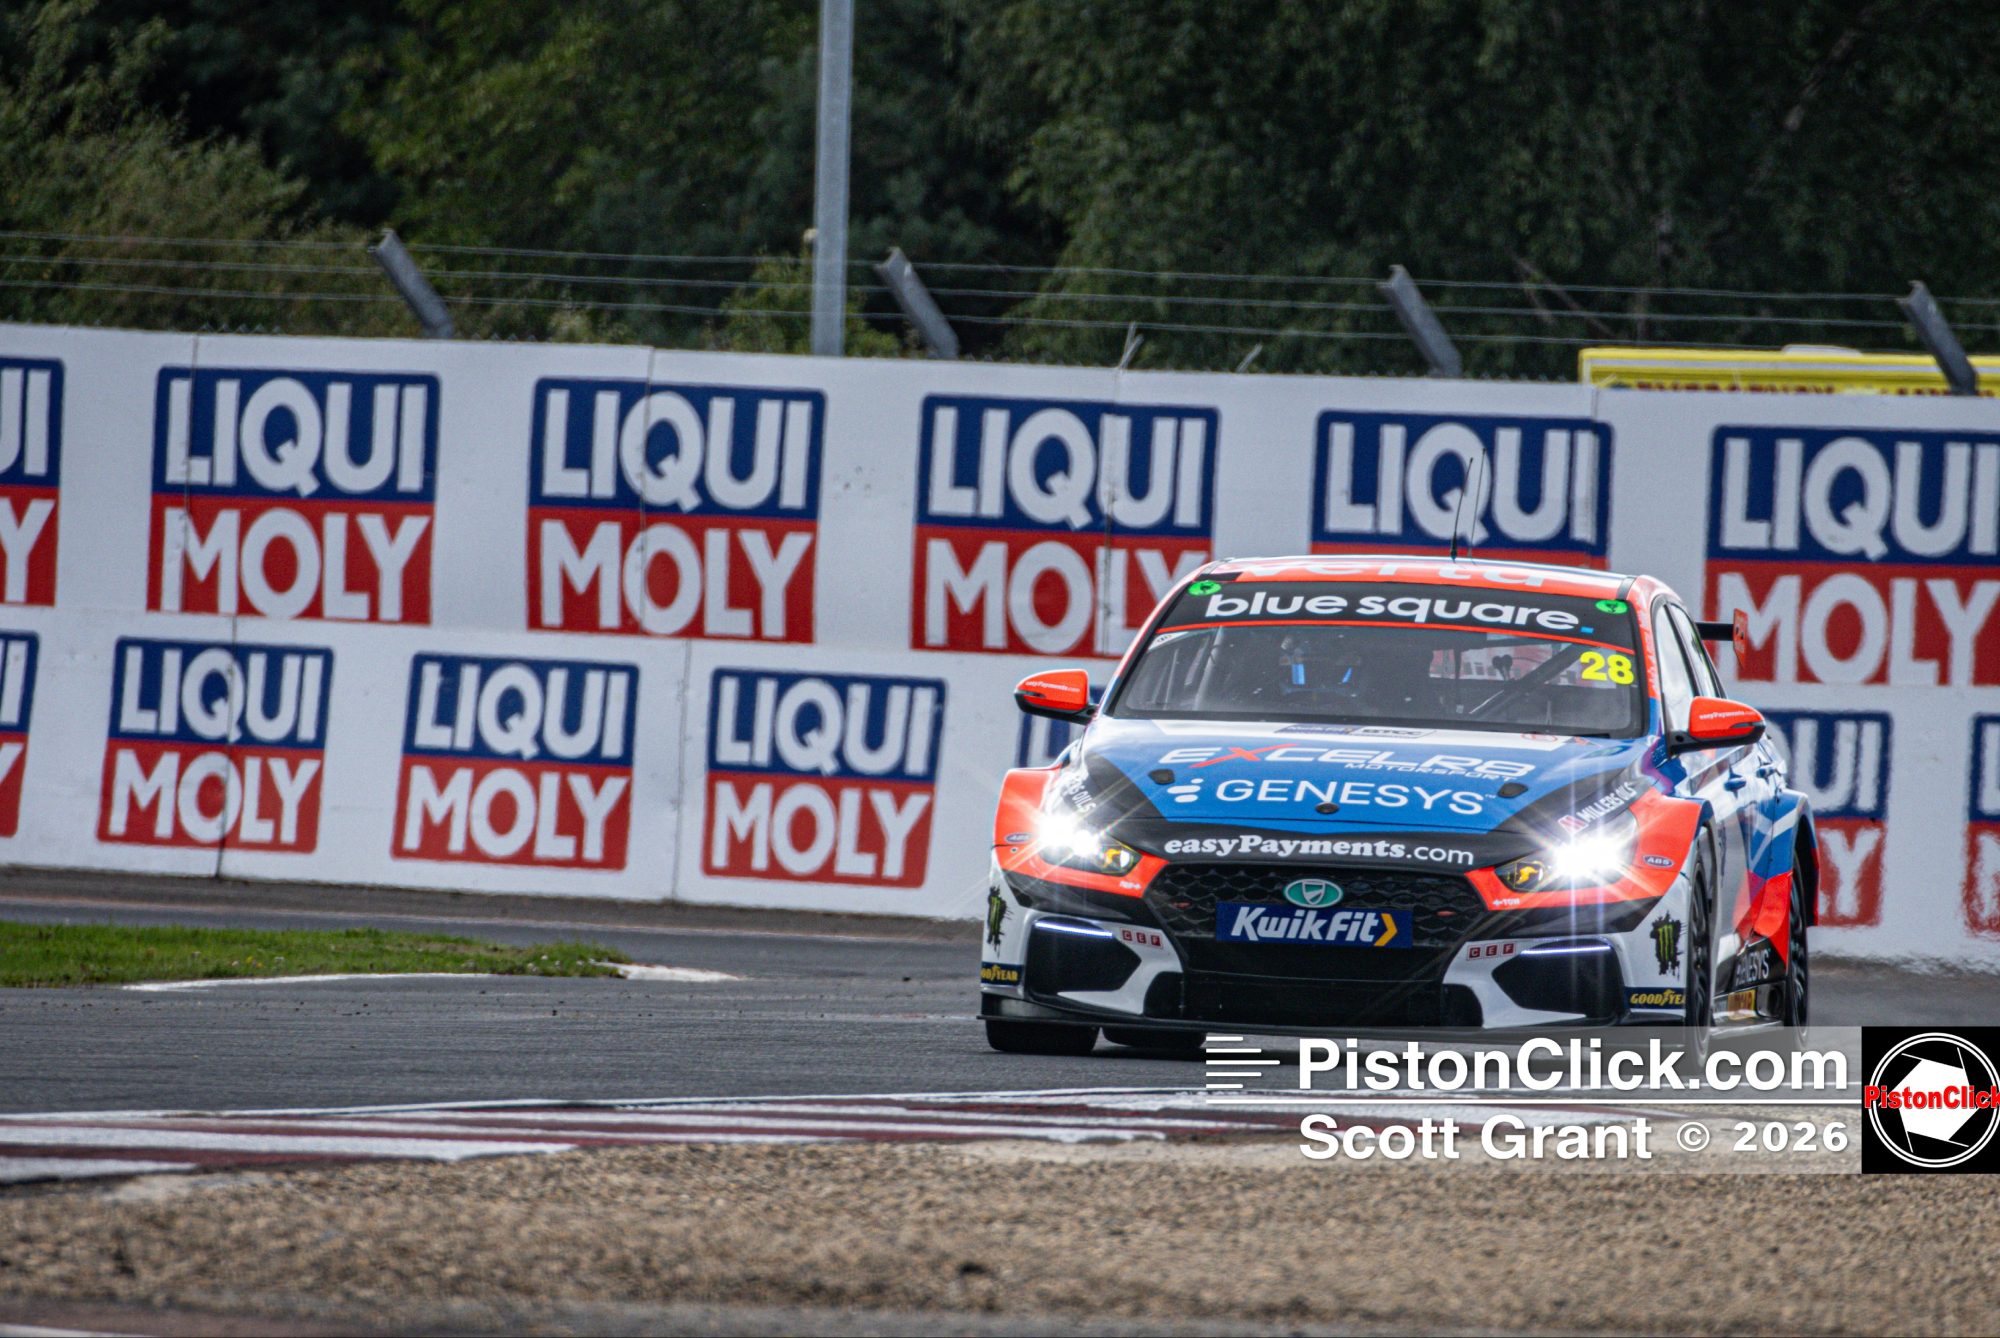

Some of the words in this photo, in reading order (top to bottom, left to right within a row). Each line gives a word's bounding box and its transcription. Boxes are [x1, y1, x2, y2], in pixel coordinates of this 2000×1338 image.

[166, 377, 428, 496] LIQUI
[541, 389, 813, 512] LIQUI
[929, 406, 1208, 529] LIQUI
[1325, 422, 1598, 544] LIQUI
[1719, 436, 1999, 561] LIQUI
[161, 505, 430, 621] MOLY
[540, 519, 813, 638] MOLY
[1205, 592, 1348, 618] blue
[1580, 651, 1634, 685] 28
[1713, 573, 2000, 686] MOLY
[119, 645, 323, 744] LIQUI
[414, 661, 629, 761] LIQUI
[715, 675, 937, 775] LIQUI
[108, 748, 321, 845] MOLY
[1158, 743, 1536, 778] EXCELR8
[1344, 763, 1519, 782] MOTORSPORT
[1576, 793, 1624, 822] MILLERS
[403, 764, 629, 861] MOLY
[710, 780, 931, 878] MOLY
[1164, 835, 1474, 865] easyPayments.com
